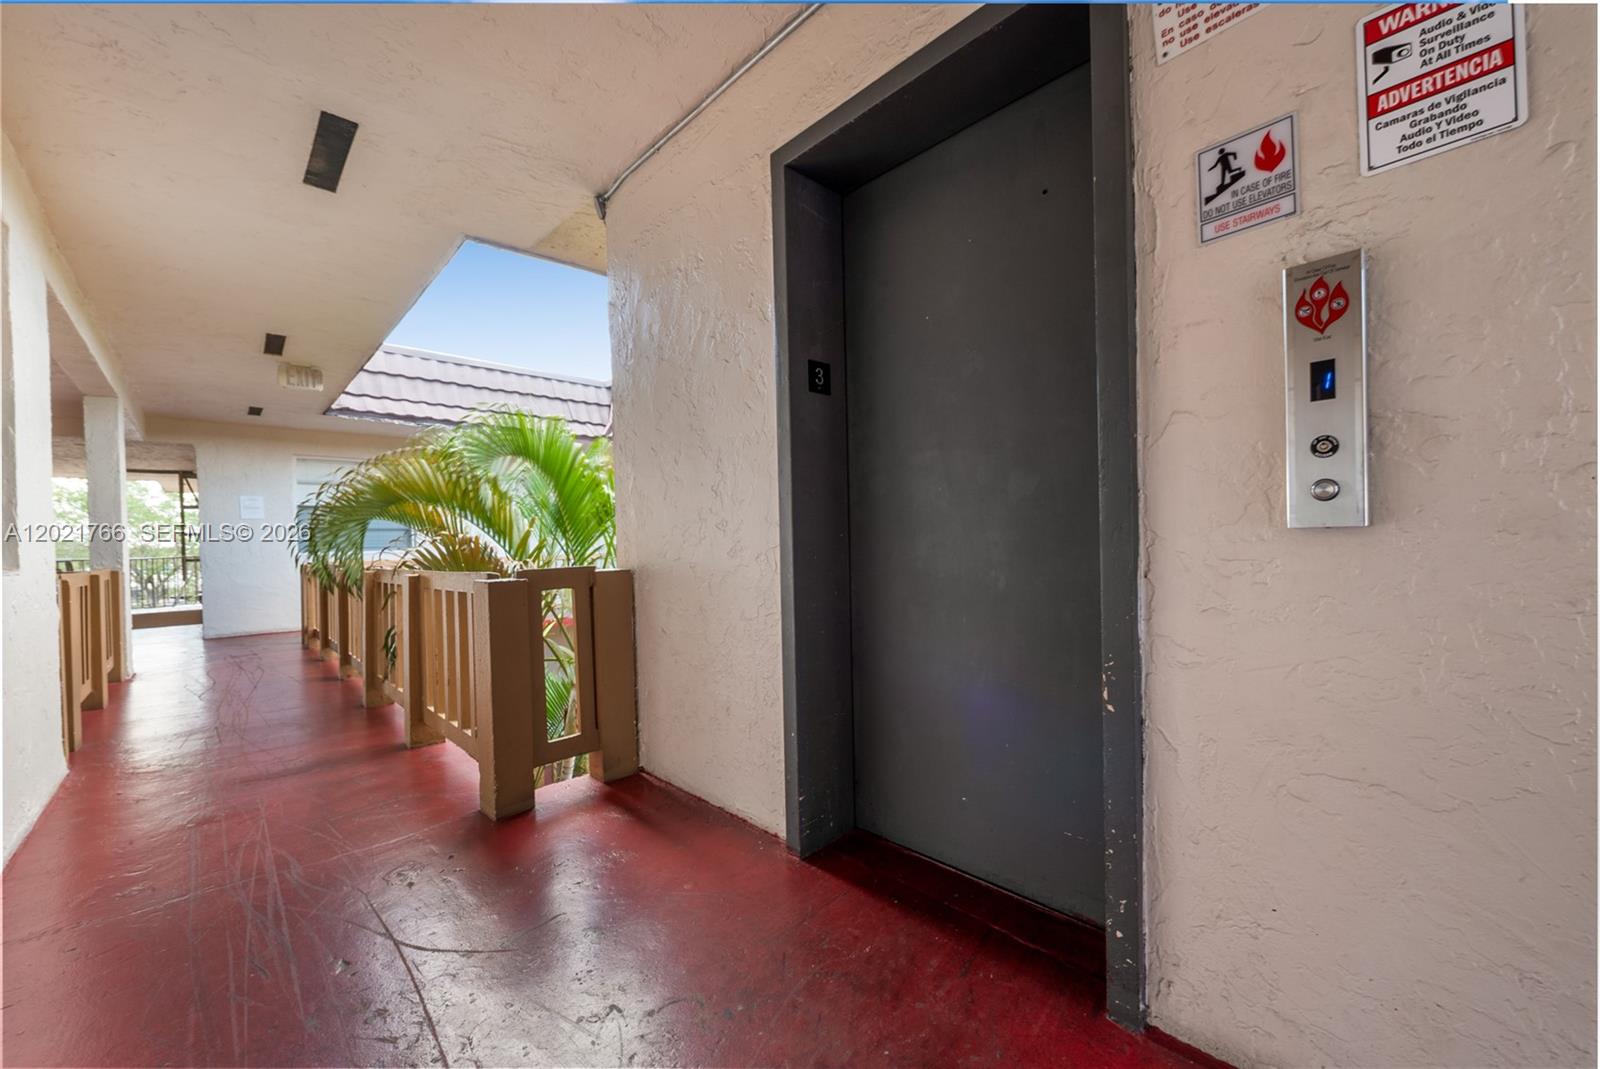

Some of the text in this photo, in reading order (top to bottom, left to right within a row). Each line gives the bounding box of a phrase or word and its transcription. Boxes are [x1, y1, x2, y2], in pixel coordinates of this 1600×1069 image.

[1161, 27, 1174, 38] En
[1179, 10, 1204, 28] caso
[1178, 3, 1197, 17] Use
[1419, 18, 1453, 37] Audio
[1457, 11, 1466, 21] &
[1162, 37, 1175, 47] no
[1180, 23, 1198, 37] use
[1180, 33, 1199, 48] Use
[1419, 11, 1495, 47] Surveillance
[1419, 34, 1466, 58] On Duty
[1420, 34, 1491, 69] At All Times
[1377, 48, 1504, 112] ADVERTENCIA
[1375, 77, 1507, 131] Camaras de Vigilancia
[1409, 102, 1468, 129] Grabando
[1396, 140, 1423, 154] Todo
[1425, 134, 1437, 144] el
[1439, 118, 1484, 139] Tiempo
[1400, 109, 1480, 143] Audio Y Video
[1231, 169, 1292, 198] IN CASE OF FIRE
[1203, 181, 1292, 219] DO NOT USE ELEVATORS
[1214, 203, 1281, 233] USE STAIRWAYS
[286, 366, 319, 388] EXIT
[815, 367, 824, 385] 3
